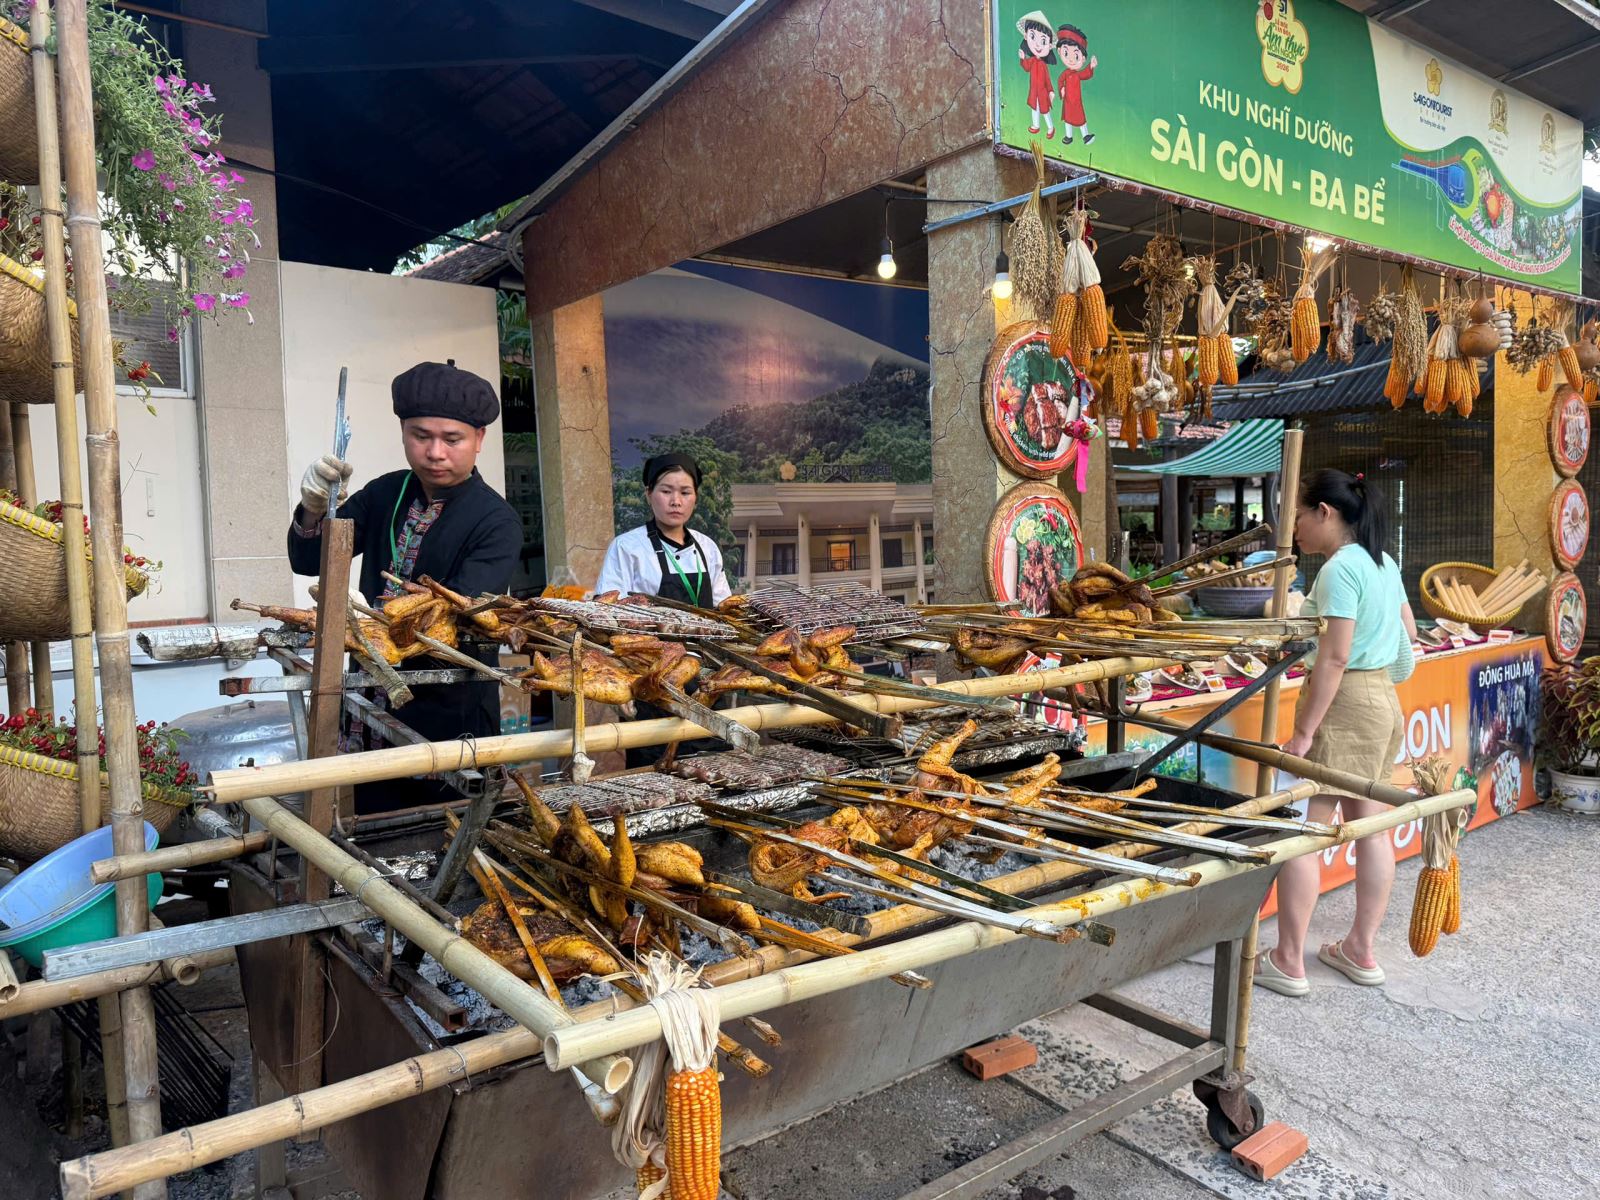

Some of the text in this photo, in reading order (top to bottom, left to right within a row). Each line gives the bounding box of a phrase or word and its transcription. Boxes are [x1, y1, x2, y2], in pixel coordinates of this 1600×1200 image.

[1199, 80, 1353, 157] KHU NGHĨ DƯỠNG
[1412, 91, 1453, 117] SAIGONTOURIST
[1150, 113, 1206, 174] SÀI
[1216, 136, 1284, 196] GÒN
[1309, 169, 1347, 215] BA
[1354, 177, 1386, 226] BỂ
[1478, 664, 1503, 689] ĐỘNG
[1522, 659, 1535, 678] MẠ
